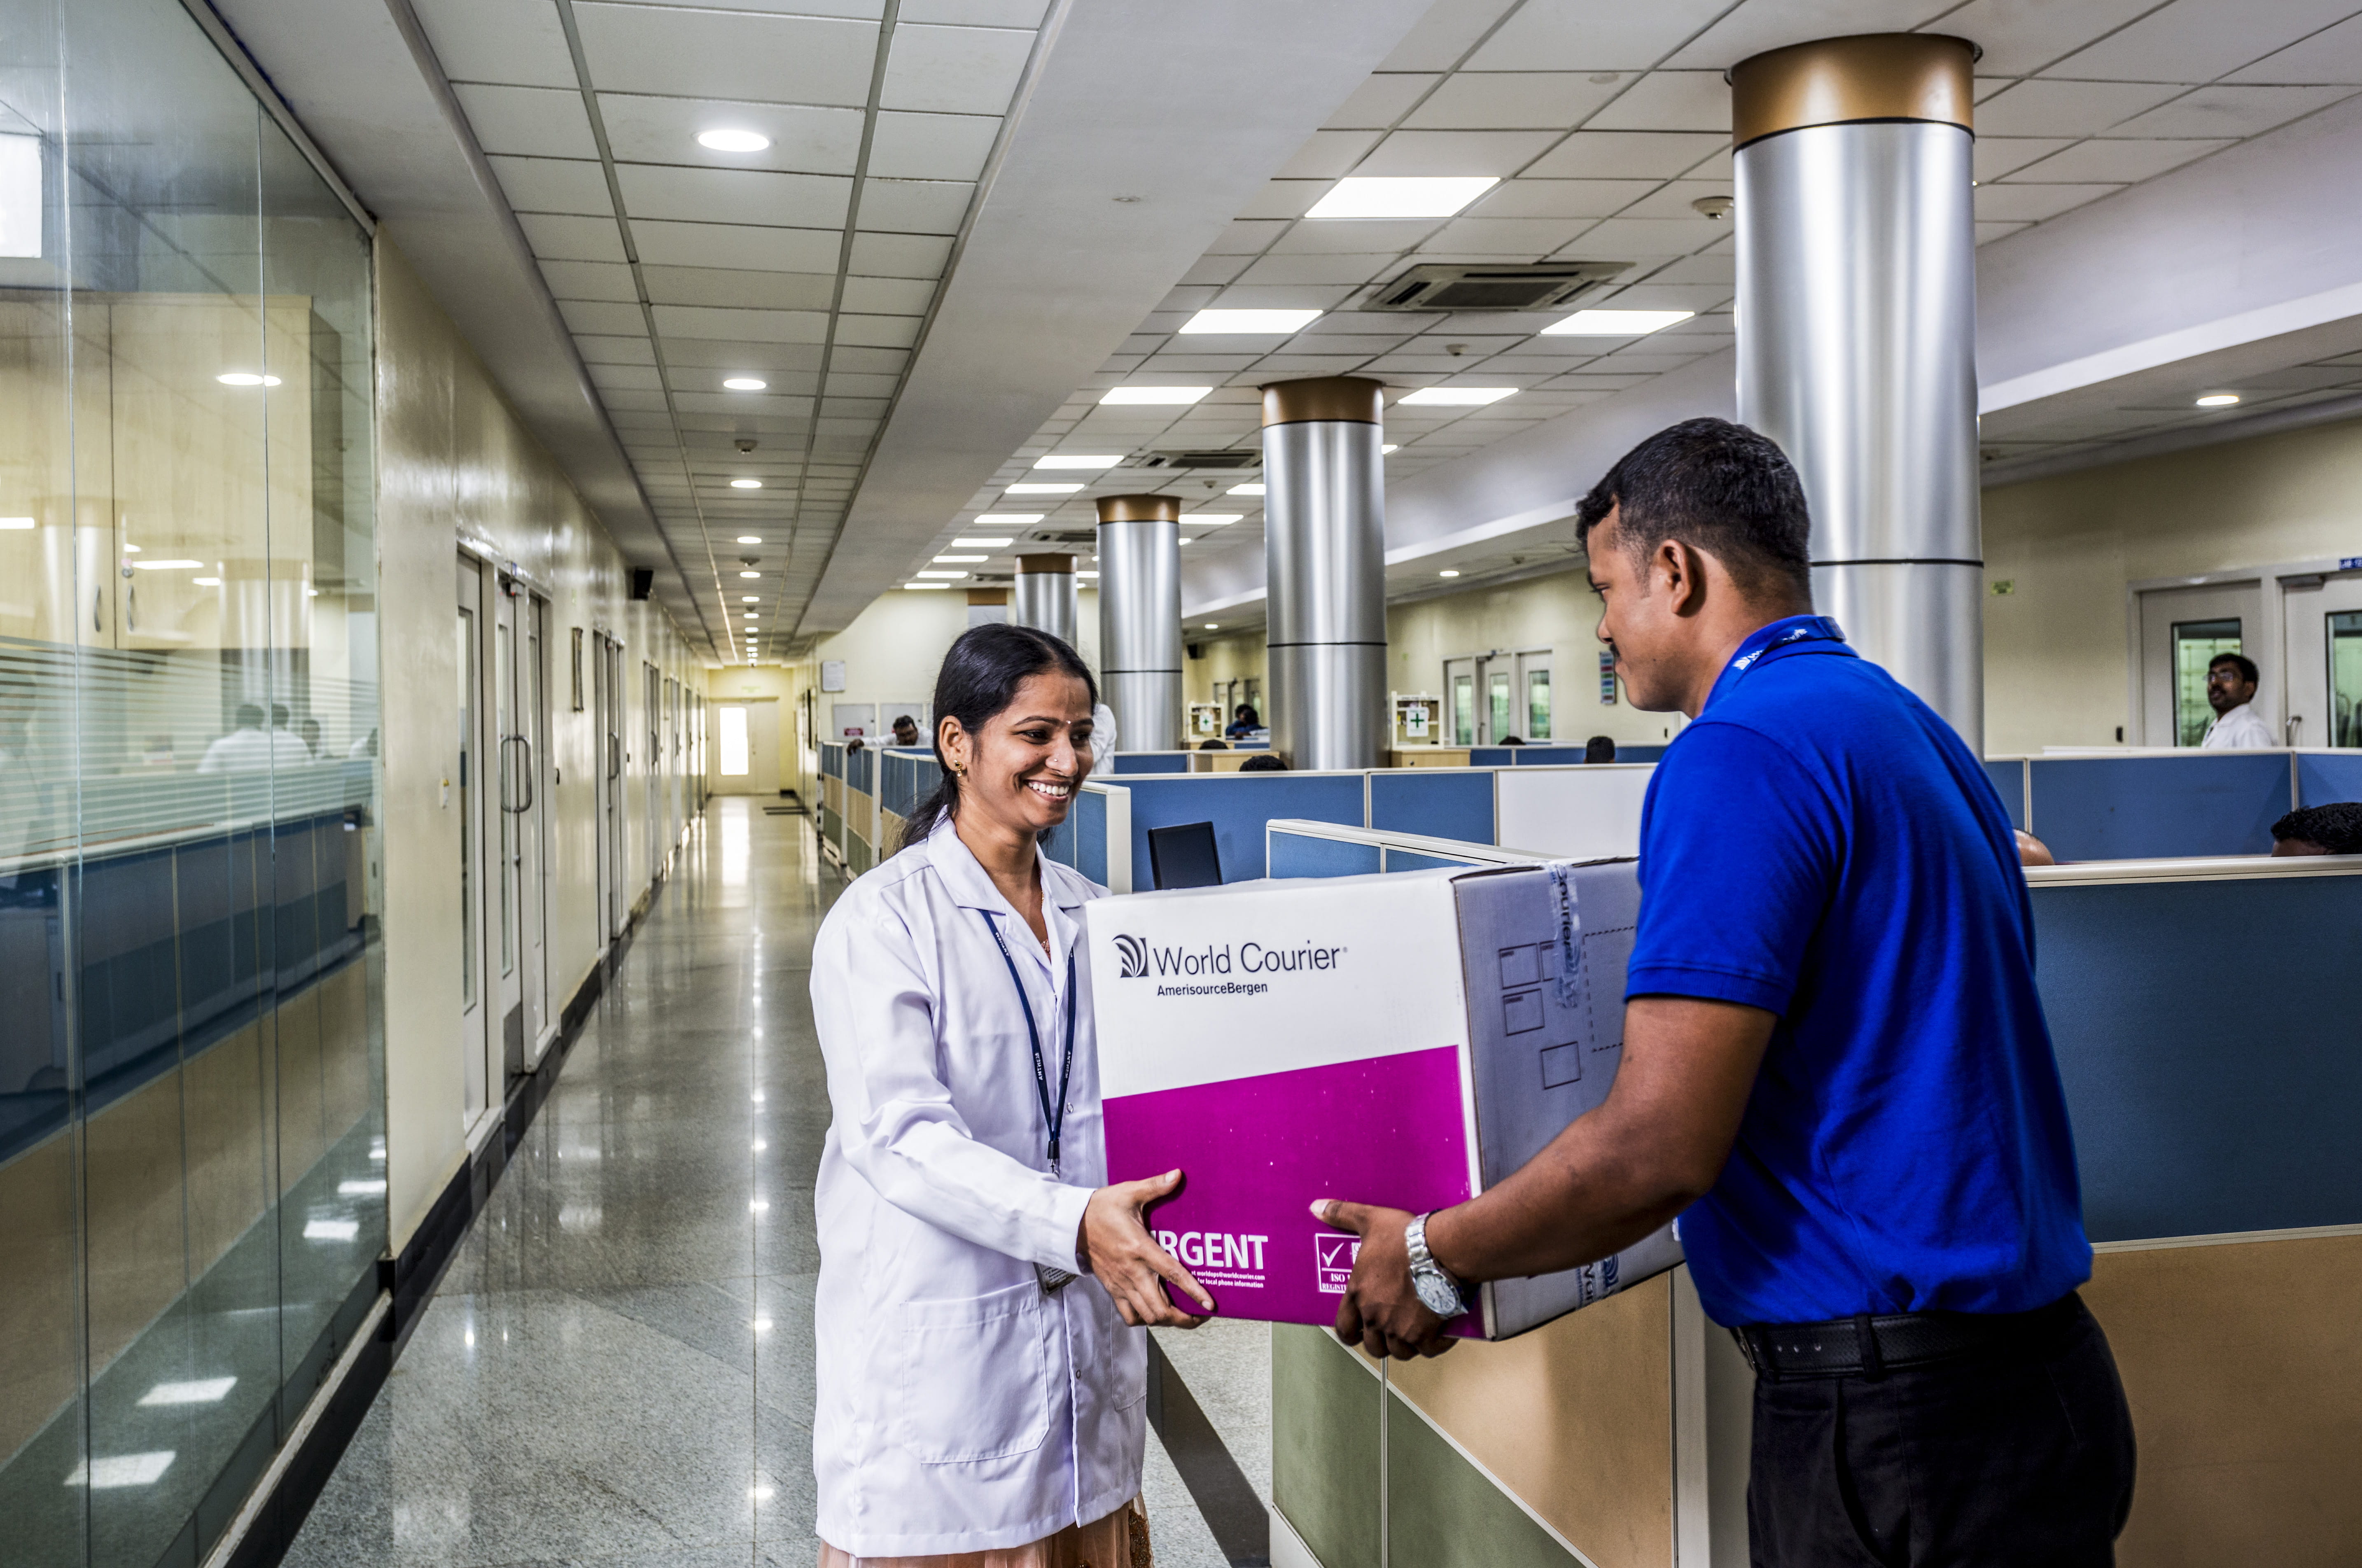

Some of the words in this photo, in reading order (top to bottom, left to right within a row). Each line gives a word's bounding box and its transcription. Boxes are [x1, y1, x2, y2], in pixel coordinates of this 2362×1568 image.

[1153, 944, 1231, 976] World
[1240, 940, 1340, 973] Courier
[1157, 982, 1268, 996] AmerisourceBergen
[1151, 1230, 1268, 1269] RGENT
[1196, 1271, 1265, 1280] worldops@worldcourier.com
[1331, 1273, 1345, 1282] ISO
[1234, 1280, 1264, 1288] information
